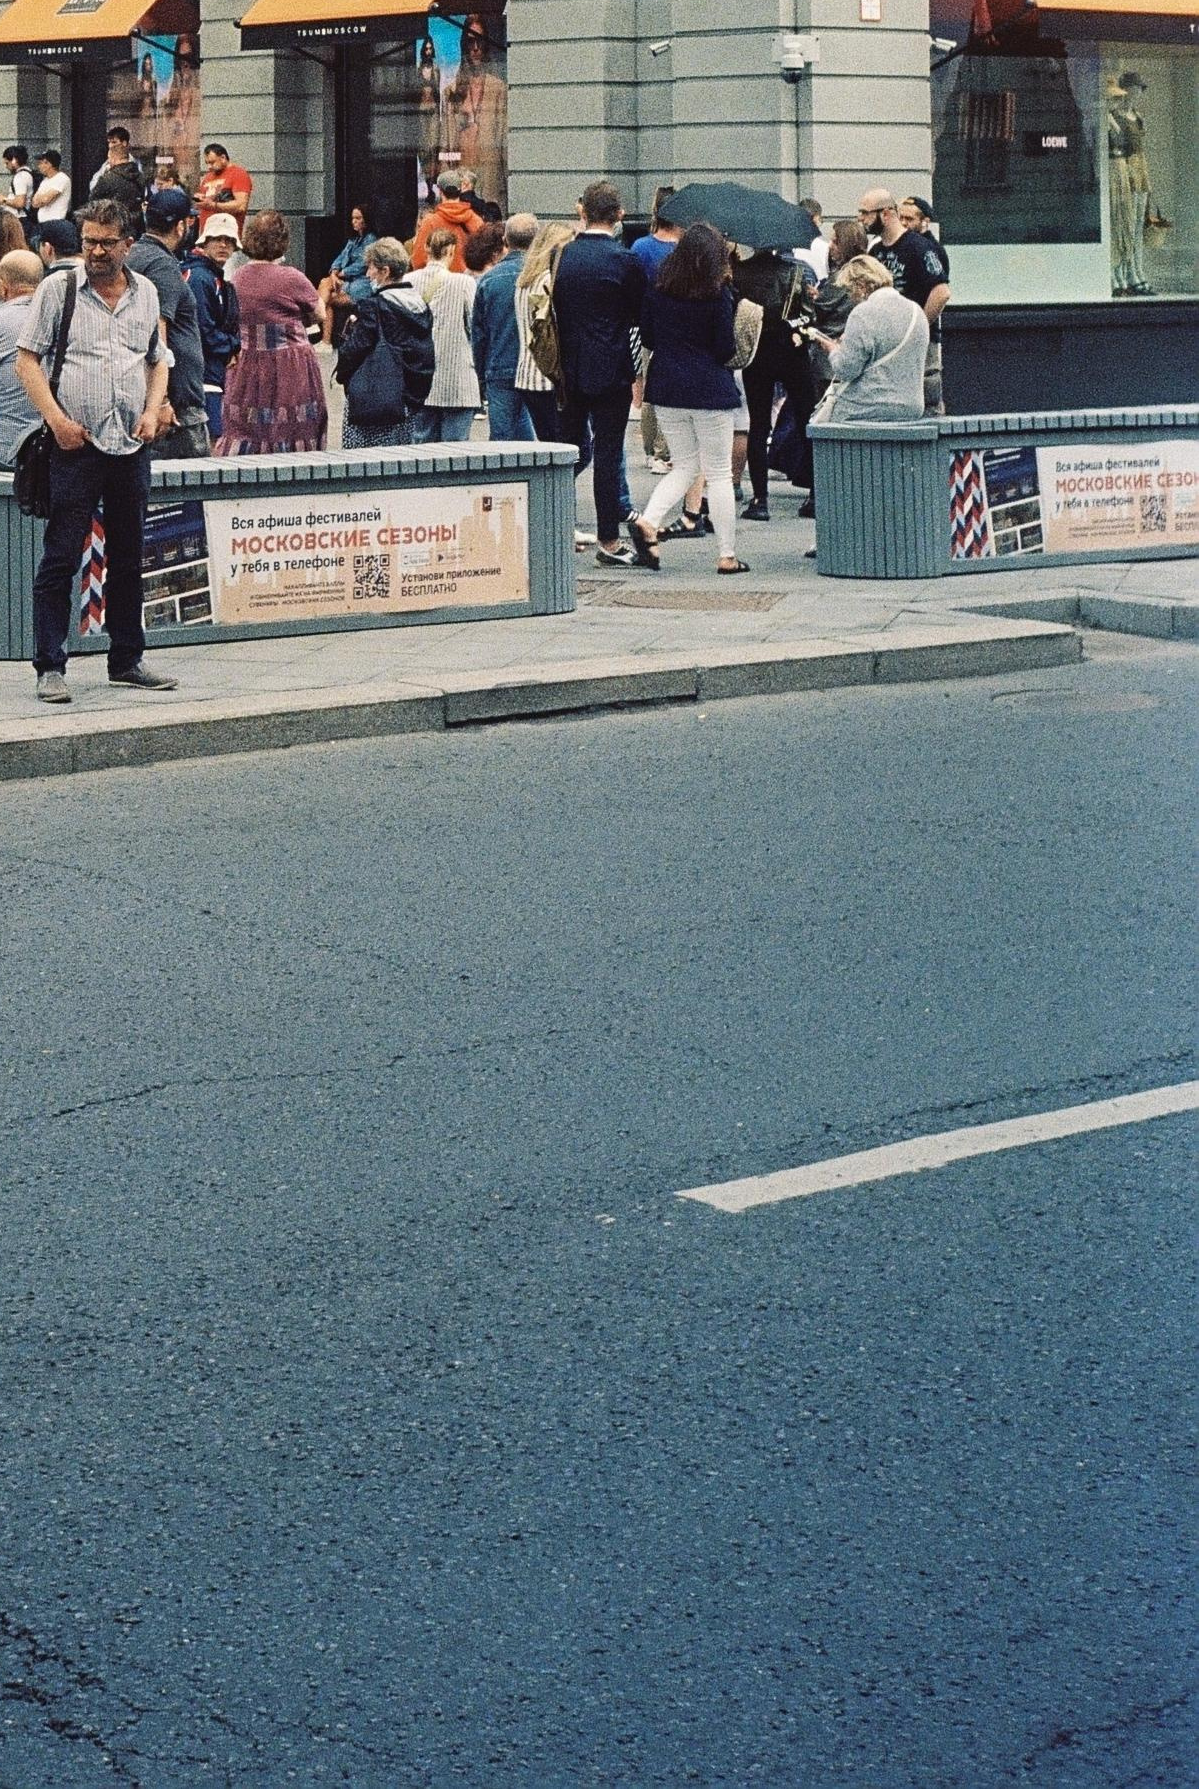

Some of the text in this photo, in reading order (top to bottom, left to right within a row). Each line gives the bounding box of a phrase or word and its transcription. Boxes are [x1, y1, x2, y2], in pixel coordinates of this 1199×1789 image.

[1056, 455, 1160, 473] Вся афиша фестивалей
[1056, 474, 1152, 493] МОСКОВСКИЕ
[231, 507, 382, 530] Вся афиша фестивалей
[231, 523, 457, 555] МОСКОВСКИЕ СЕЗОНЫ
[230, 554, 345, 577] у тебя в телефоне
[401, 566, 502, 584] Установи приложение
[401, 582, 458, 597] БЕСПЛАТНО
